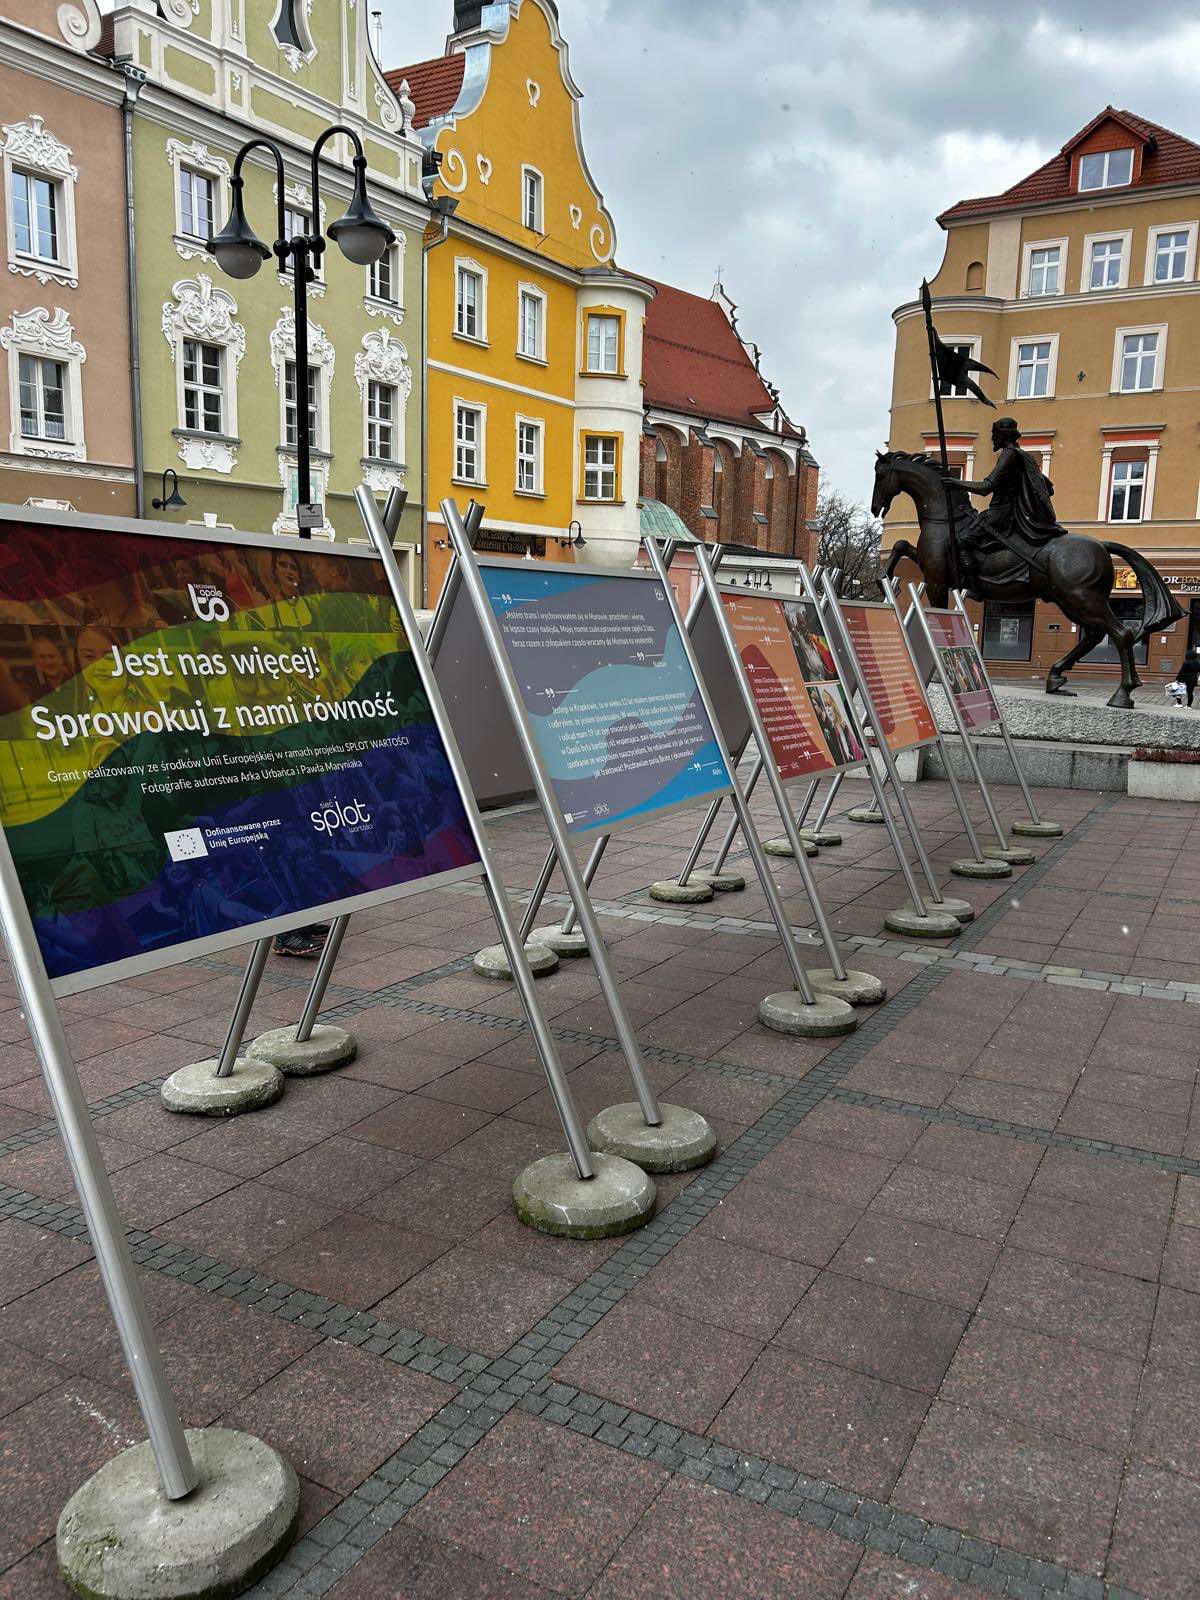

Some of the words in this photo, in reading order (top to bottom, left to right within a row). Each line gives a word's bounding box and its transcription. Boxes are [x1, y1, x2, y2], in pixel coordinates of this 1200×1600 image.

[111, 645, 174, 677] Jest
[177, 653, 228, 675] nas
[231, 646, 320, 680] więcej!
[31, 700, 210, 747] Sprowokuj
[213, 707, 231, 729] z
[235, 696, 299, 727] nami
[303, 691, 399, 722] równość
[47, 769, 82, 783] Grant
[83, 764, 145, 780] realizowany
[147, 763, 159, 773] ze
[161, 757, 201, 772] środków
[202, 754, 222, 767] Unii
[223, 751, 275, 767] Europejskiej
[276, 751, 284, 760] w
[284, 747, 314, 758] ramach
[313, 743, 345, 757] projektu
[345, 740, 370, 752] SPLOT
[371, 736, 410, 749] WARTOŚCI
[141, 779, 193, 795] Fotografie
[193, 773, 239, 788] autorstwa
[240, 771, 261, 782] Arka
[262, 767, 296, 780] Urbańca
[301, 763, 325, 775] Pawła
[325, 759, 363, 772] Maryniaka
[205, 823, 261, 837] Dofinansowane
[262, 818, 281, 830] przez
[310, 797, 371, 837] splot
[209, 840, 227, 849] Unię
[228, 832, 270, 846] Europejską
